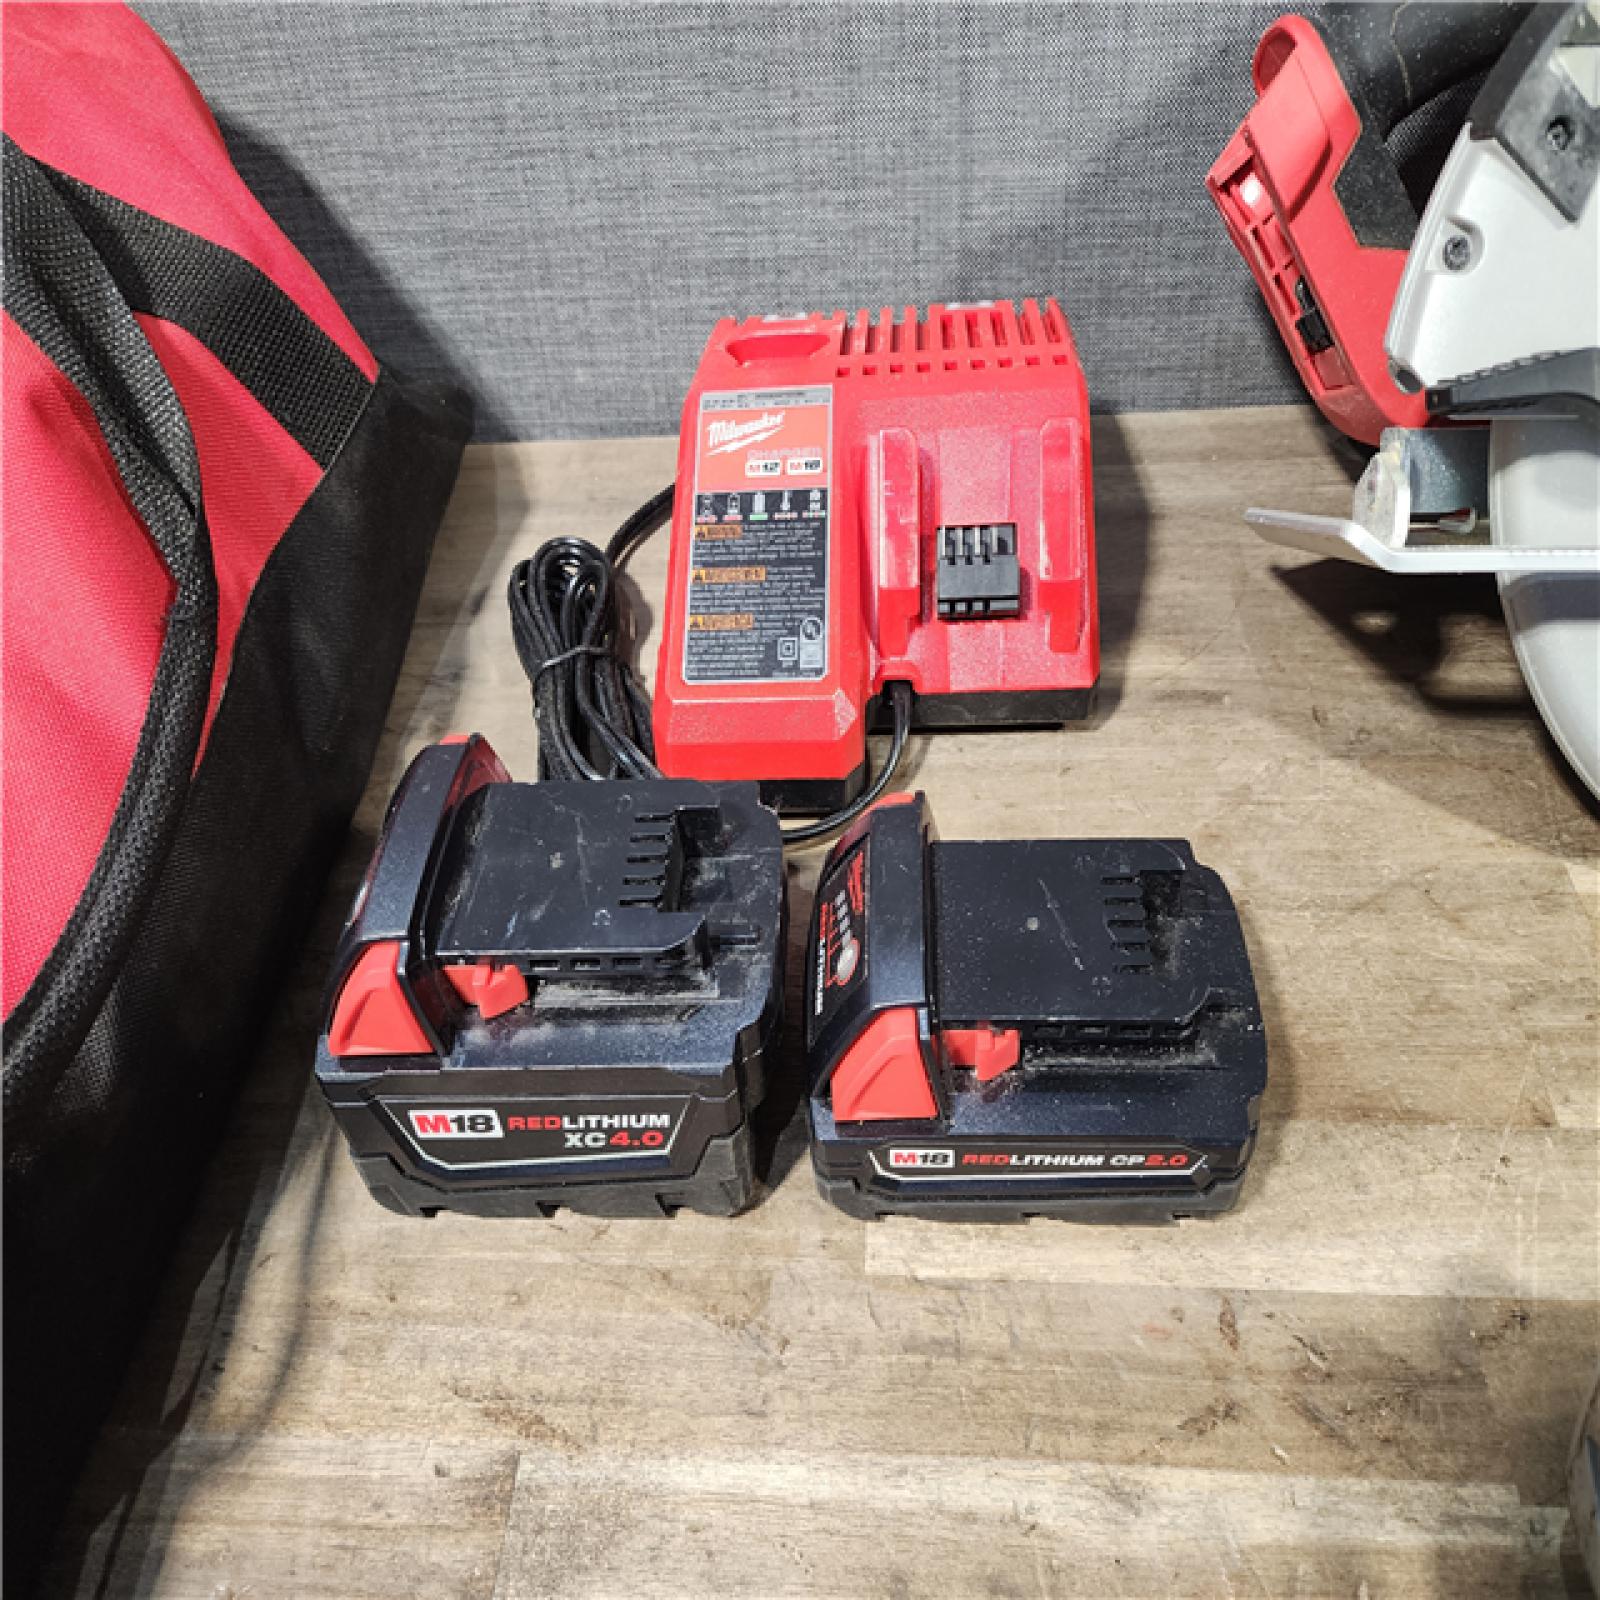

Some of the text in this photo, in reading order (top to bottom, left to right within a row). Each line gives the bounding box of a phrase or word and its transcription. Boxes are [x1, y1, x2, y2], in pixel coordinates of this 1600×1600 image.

[707, 410, 786, 448] Milwaukee
[414, 1114, 671, 1134] M18 REDLITHIUM
[564, 1129, 664, 1149] XC 4.0
[894, 1152, 950, 1166] M18
[962, 1153, 1106, 1167] REDLITHIUM
